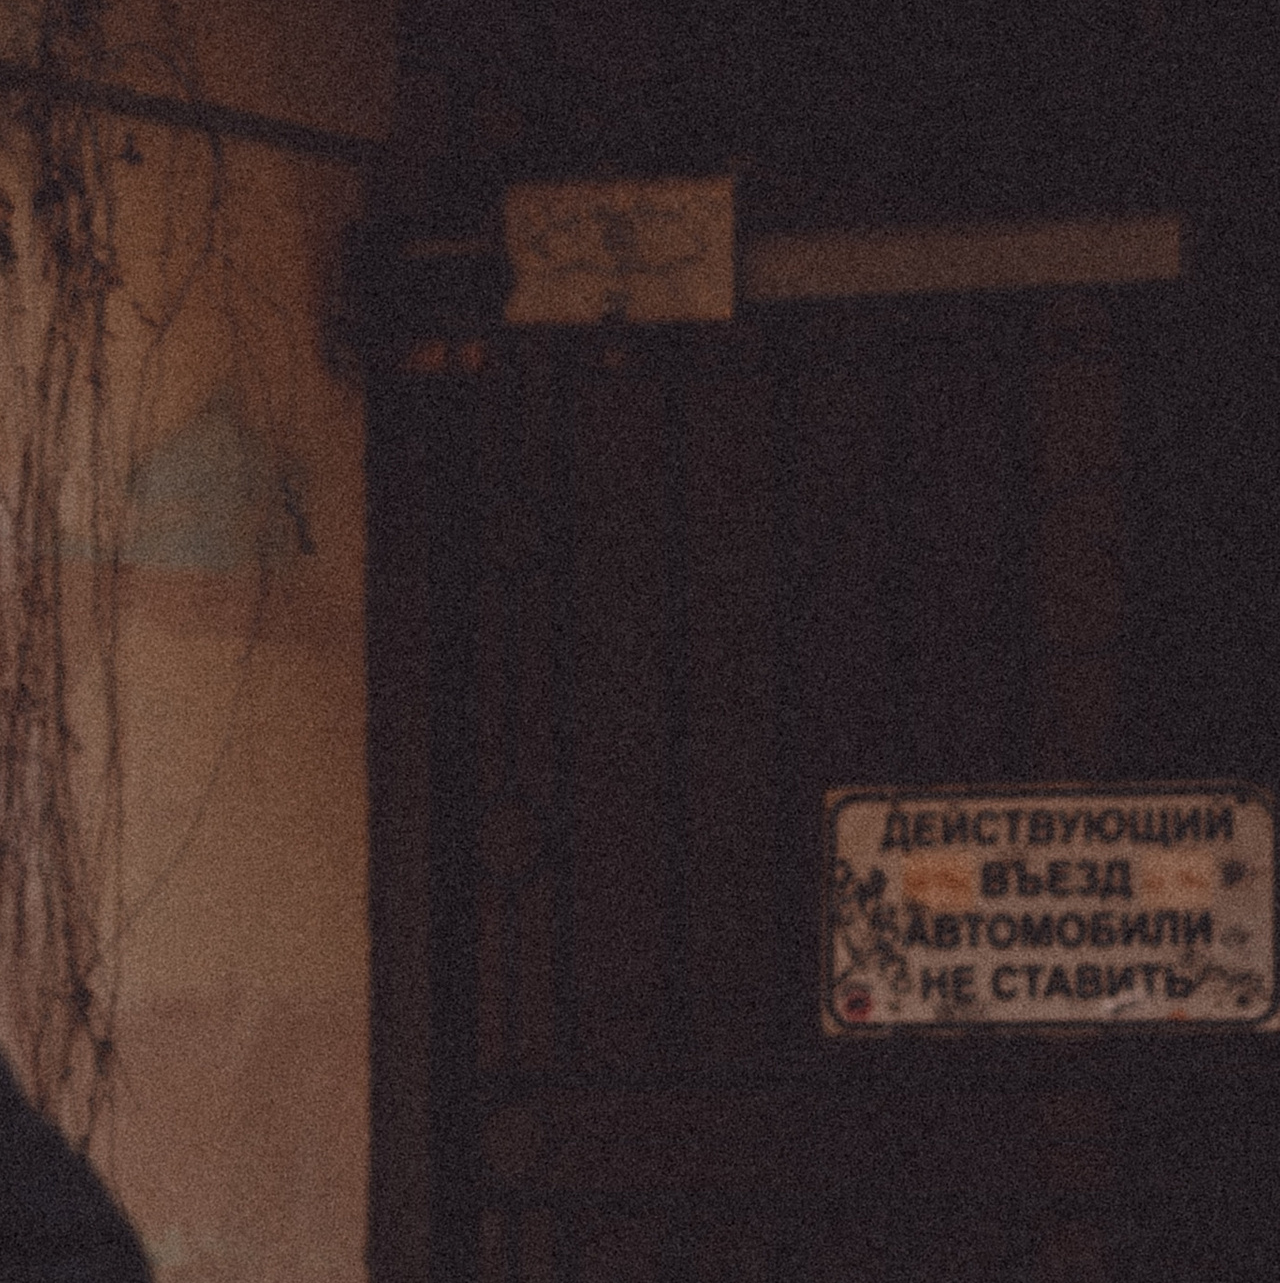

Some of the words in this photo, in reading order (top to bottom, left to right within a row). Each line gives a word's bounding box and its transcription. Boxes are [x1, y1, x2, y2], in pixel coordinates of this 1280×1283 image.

[881, 802, 1234, 852] ДЕЙСТВУЮЩИЙ
[980, 860, 1133, 900] ВЪЕЗД
[905, 910, 1214, 950] АВТОМОБИЛИ
[921, 965, 975, 1003] НЕ
[992, 963, 1195, 1000] СТАВИТЬ
